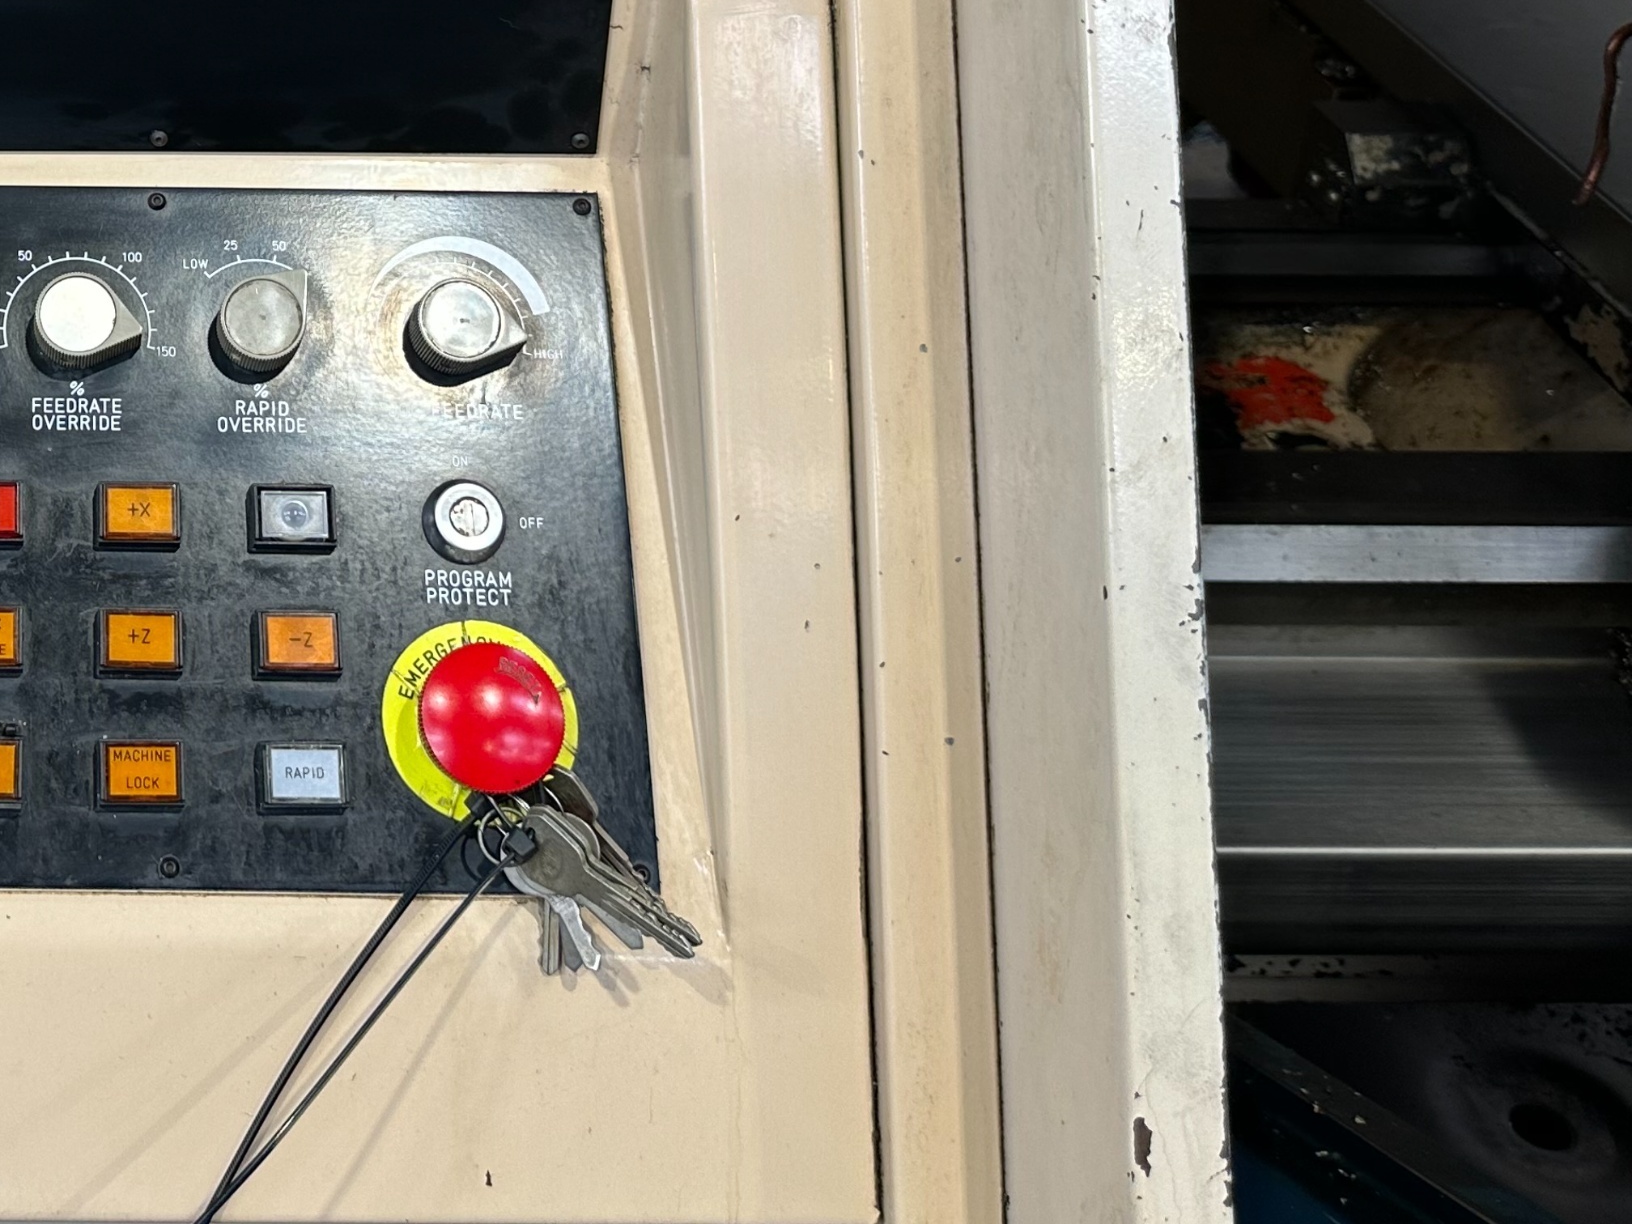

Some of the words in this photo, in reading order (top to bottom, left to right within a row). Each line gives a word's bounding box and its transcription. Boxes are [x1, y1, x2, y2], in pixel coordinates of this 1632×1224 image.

[224, 240, 238, 250] 25
[272, 241, 287, 251] 50
[18, 250, 32, 262] 50
[122, 252, 142, 263] 100
[183, 259, 209, 269] LOW
[156, 346, 176, 358] 150
[534, 349, 563, 359] HIGH
[69, 381, 84, 396] %
[253, 383, 270, 398] %
[31, 398, 122, 414] FEEDRATE
[235, 400, 290, 416] RAPID
[31, 416, 122, 432] OVERRIDE
[217, 417, 307, 433] OVERRIDE
[452, 456, 468, 467] ON
[128, 501, 150, 517] +X
[519, 517, 544, 529] OFF
[424, 570, 513, 587] PROGRAM
[426, 589, 512, 605] PROTECT
[128, 628, 151, 644] +Z
[112, 749, 171, 763] MACHINE
[285, 766, 325, 779] RAPID
[126, 776, 160, 789] LOCK
